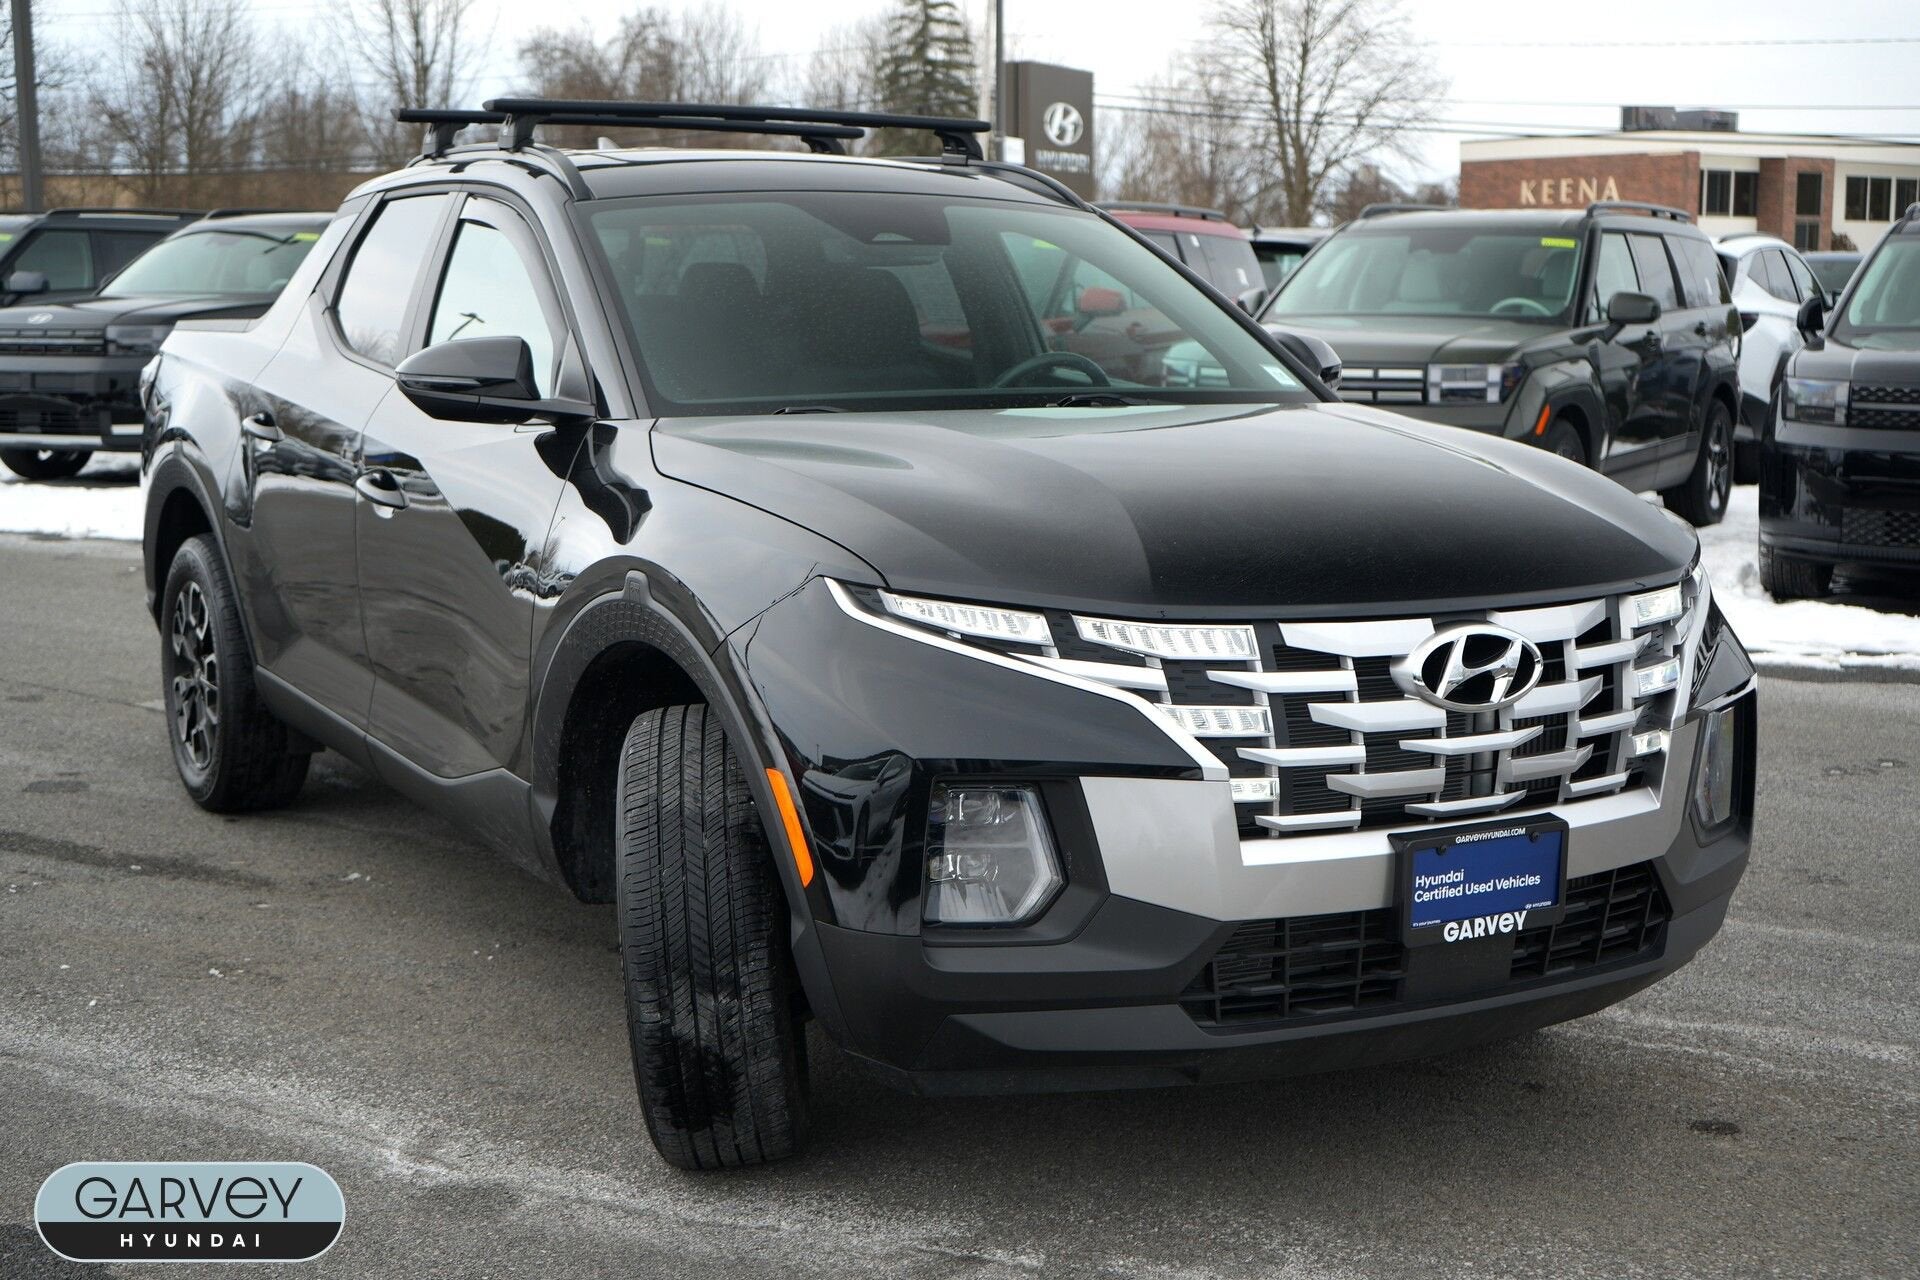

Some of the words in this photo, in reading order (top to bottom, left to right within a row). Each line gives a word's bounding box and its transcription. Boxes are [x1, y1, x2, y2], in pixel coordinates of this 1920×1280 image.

[1520, 175, 1621, 206] KEENA
[1414, 884, 1463, 903] Certified
[1465, 879, 1494, 895] Used
[1495, 873, 1541, 891] Vehicles
[1415, 869, 1465, 888] Hyundai
